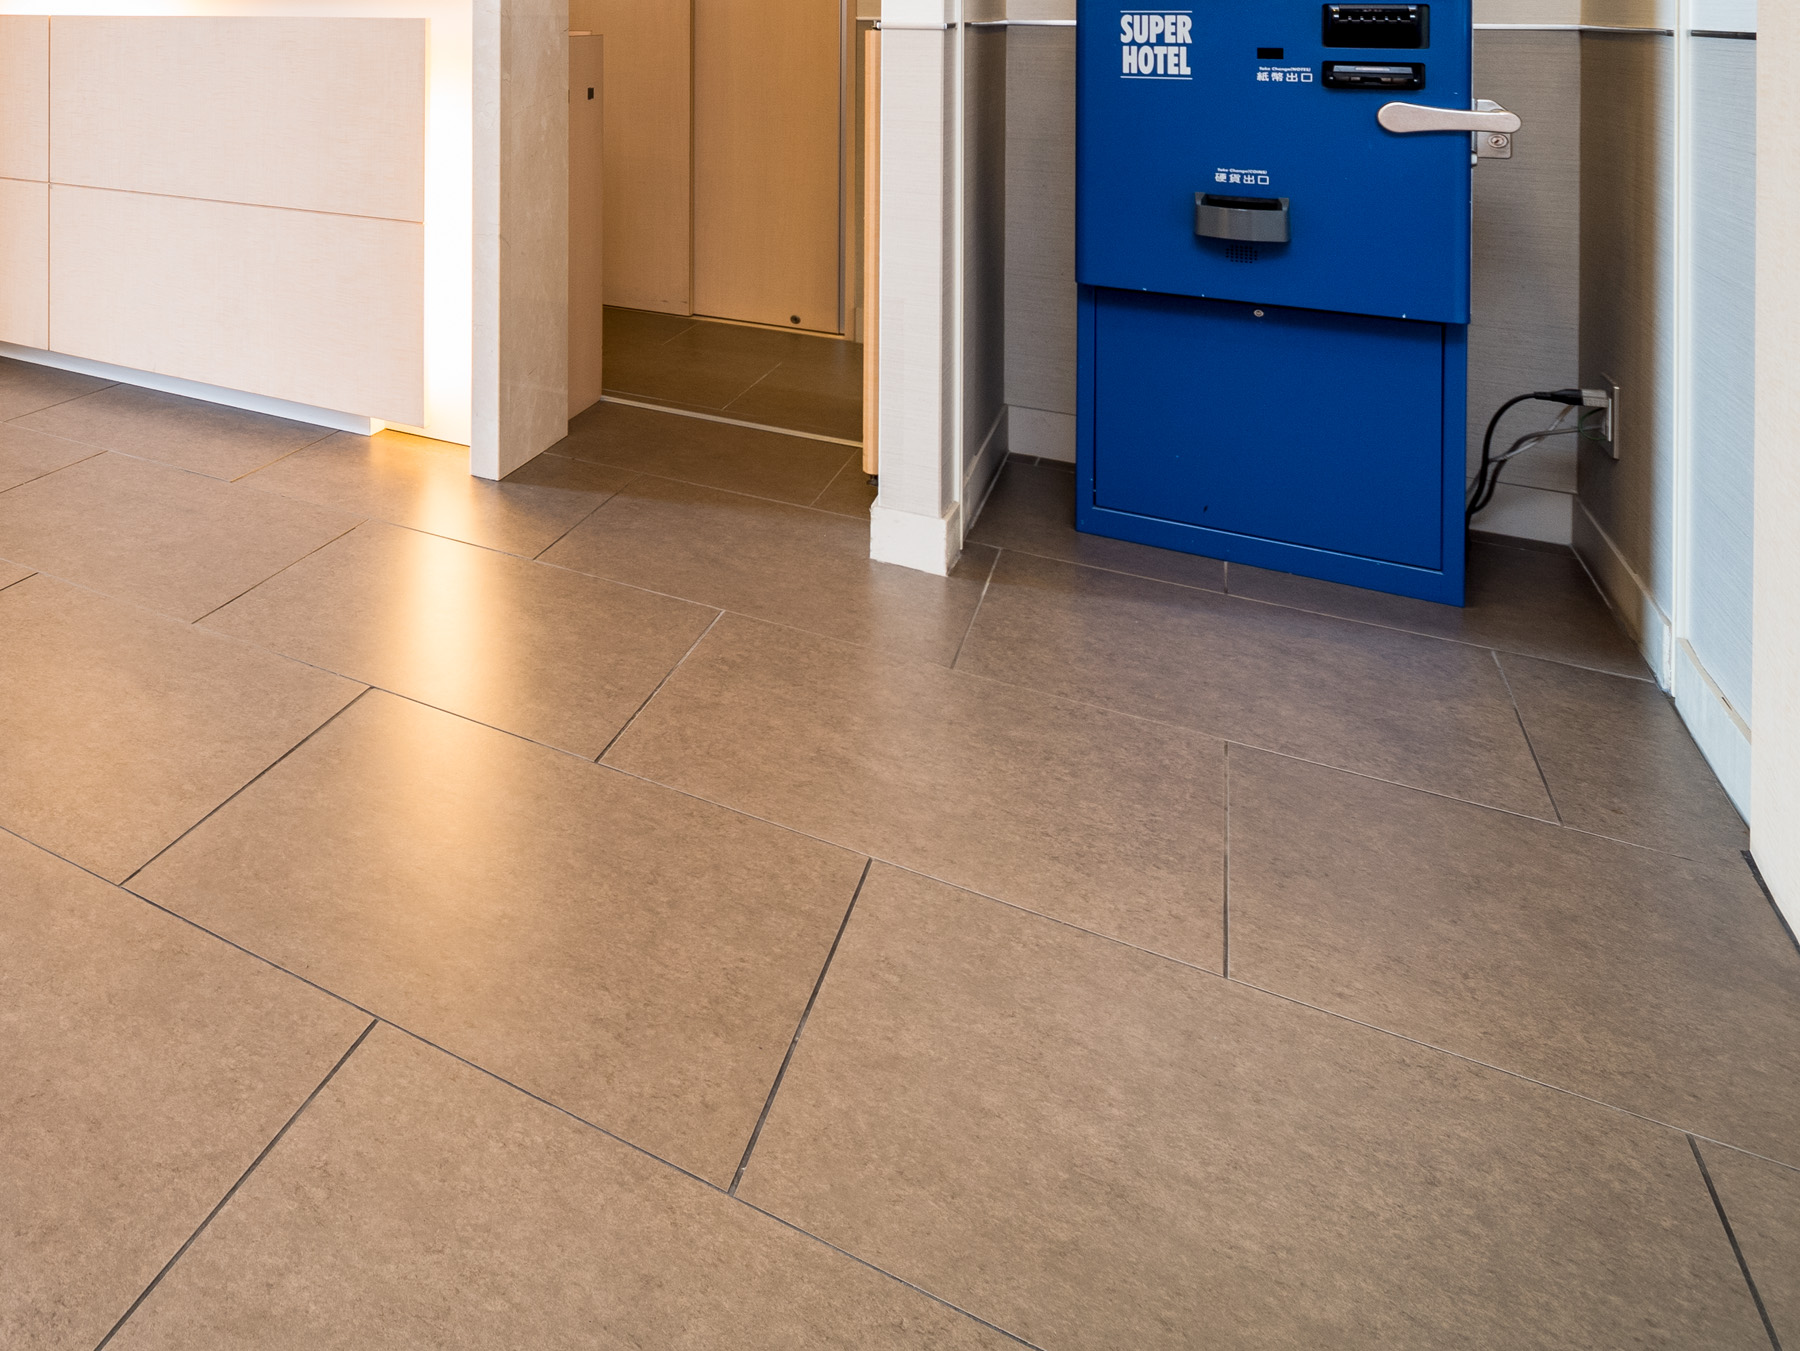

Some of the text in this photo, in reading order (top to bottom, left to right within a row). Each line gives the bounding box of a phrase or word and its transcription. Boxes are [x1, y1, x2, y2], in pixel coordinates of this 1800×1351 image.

[1120, 14, 1192, 44] SUPER
[1122, 45, 1191, 75] HOTEL
[1256, 72, 1313, 82] 紙幣出口
[1214, 173, 1270, 185] 硬貨出口
